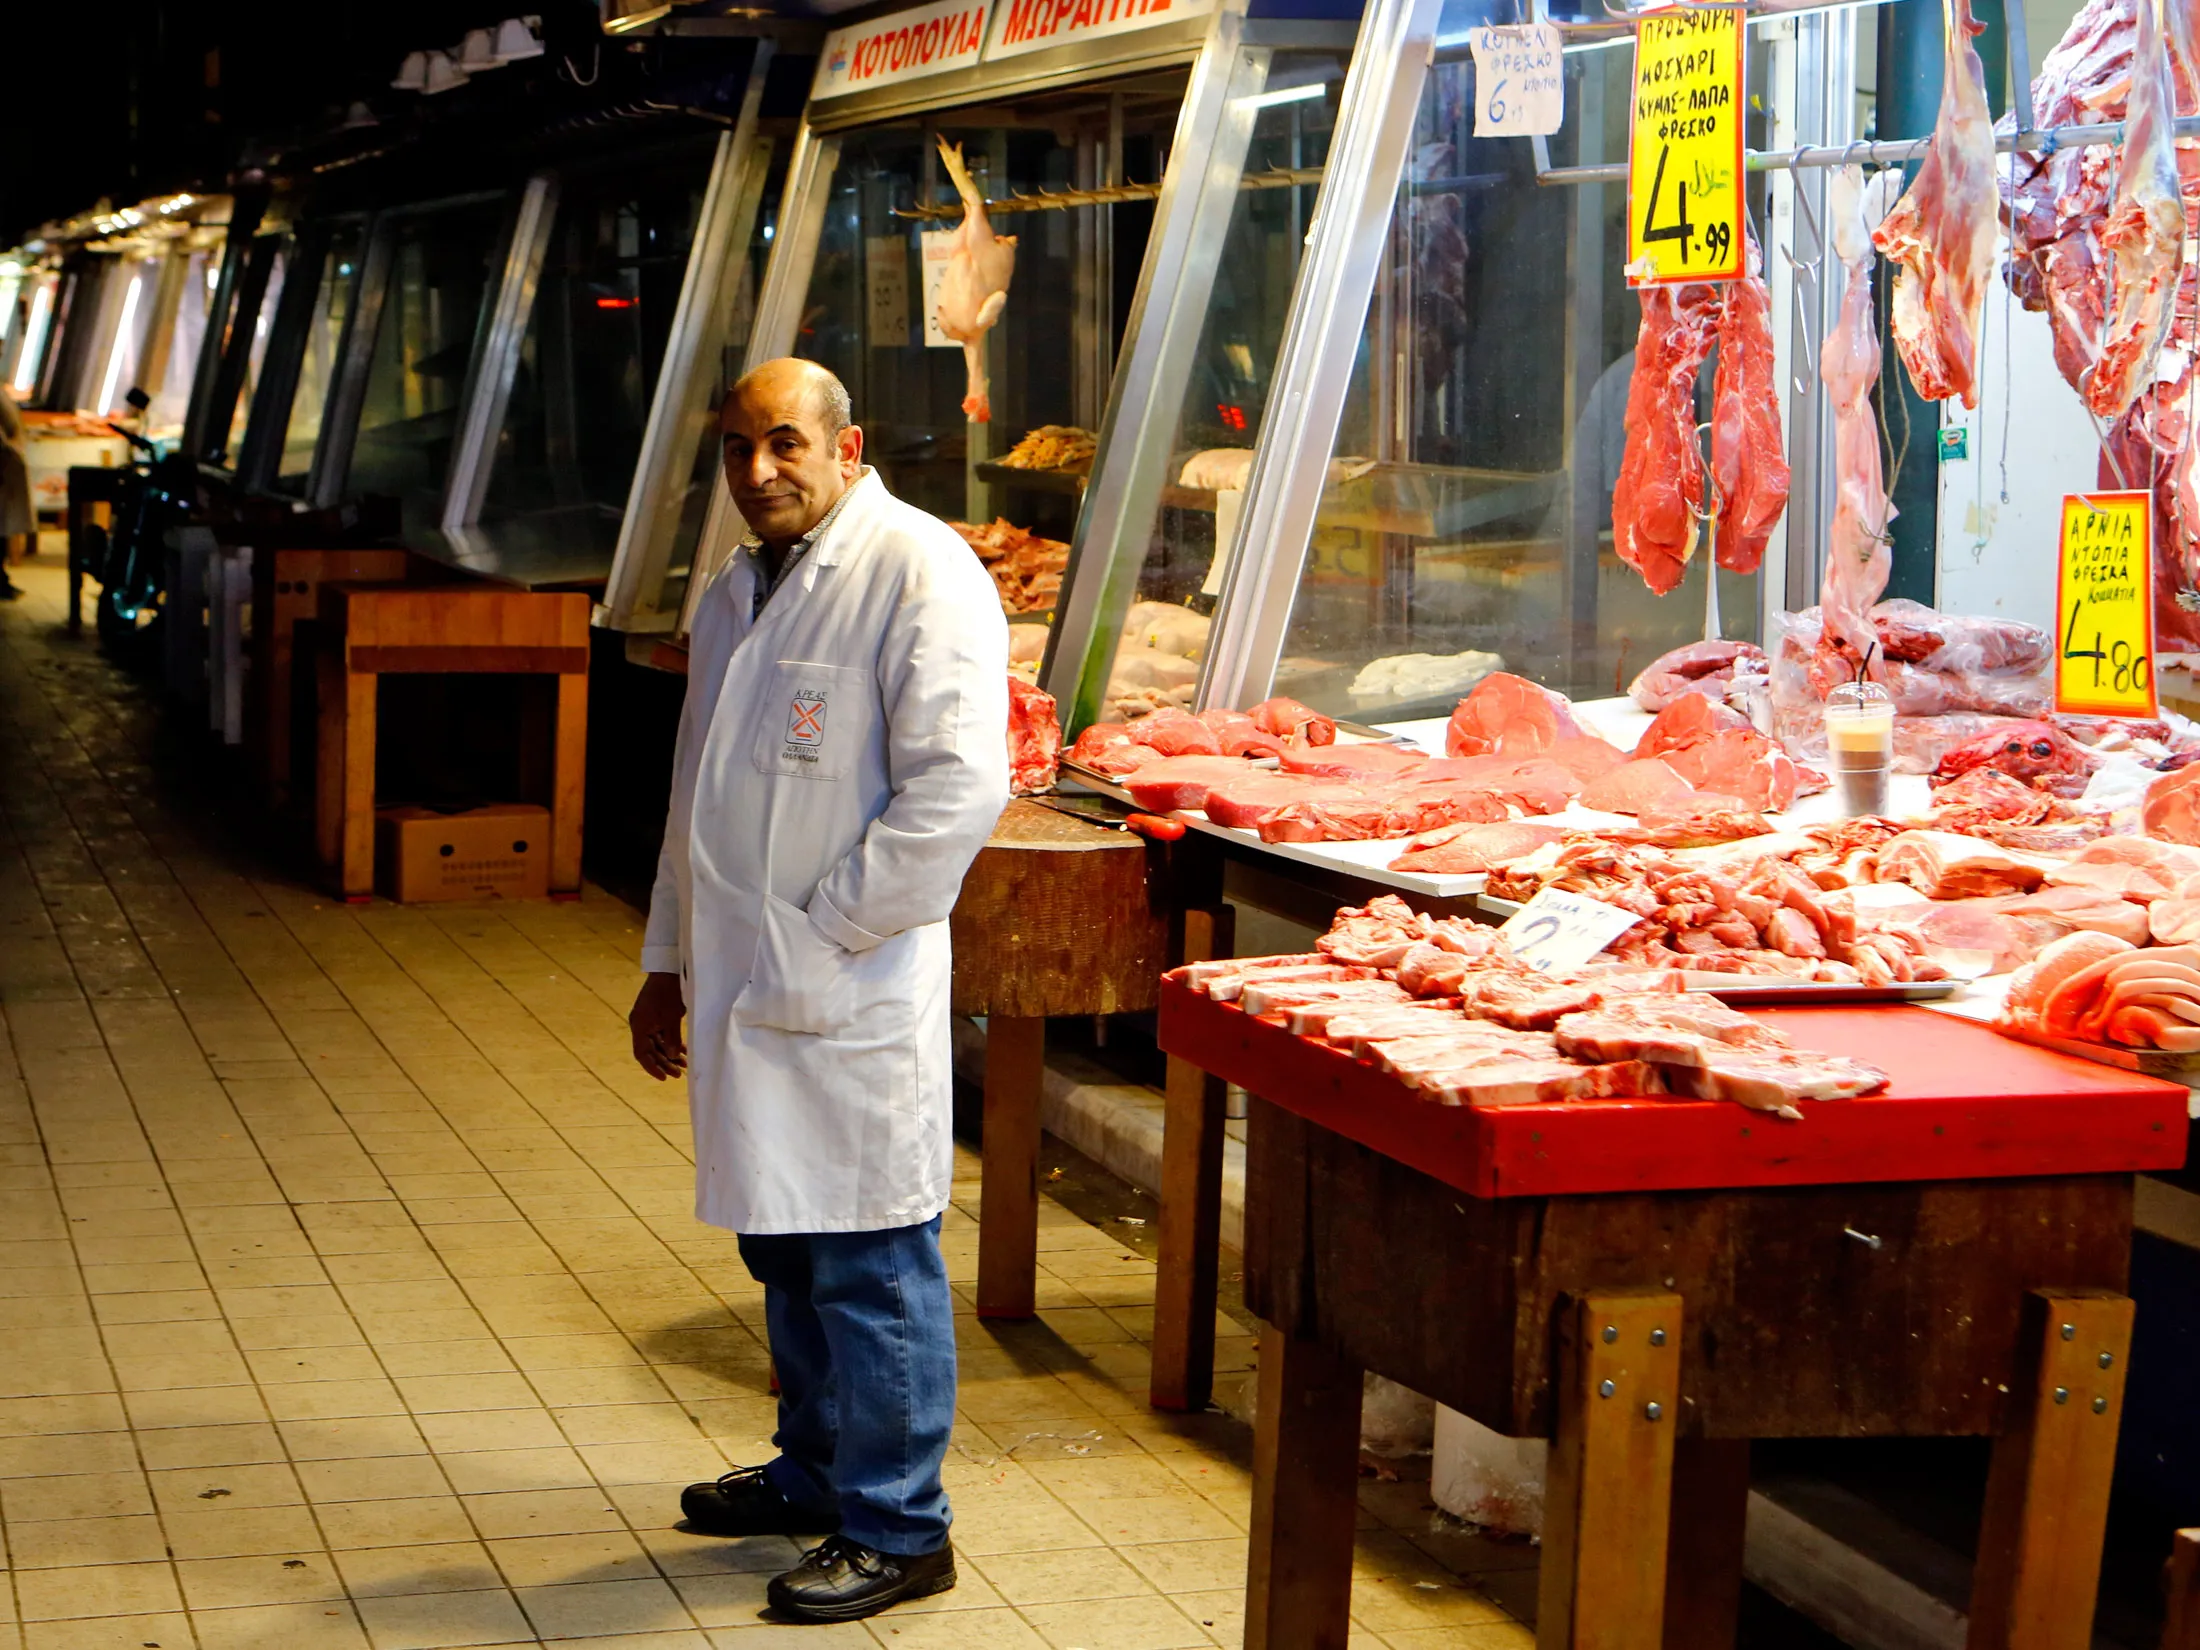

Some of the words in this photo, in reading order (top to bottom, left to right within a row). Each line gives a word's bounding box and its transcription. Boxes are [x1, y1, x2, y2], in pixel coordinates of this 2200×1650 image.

[848, 6, 985, 81] ΚΟΤΟΠΟΥΛΑ
[1641, 48, 1715, 87] ΜΟΣΧΑΡΙ
[1659, 116, 1716, 140] ΦΡΕΣΚΟ
[1643, 143, 1730, 267] 4.99
[2071, 512, 2133, 542] ΑΡΝΙΑ
[2071, 545, 2128, 564] ΝΤΟΠΙΑ
[2073, 566, 2128, 583] ΦΡΕΣΚΑ
[2064, 599, 2150, 693] 4.80
